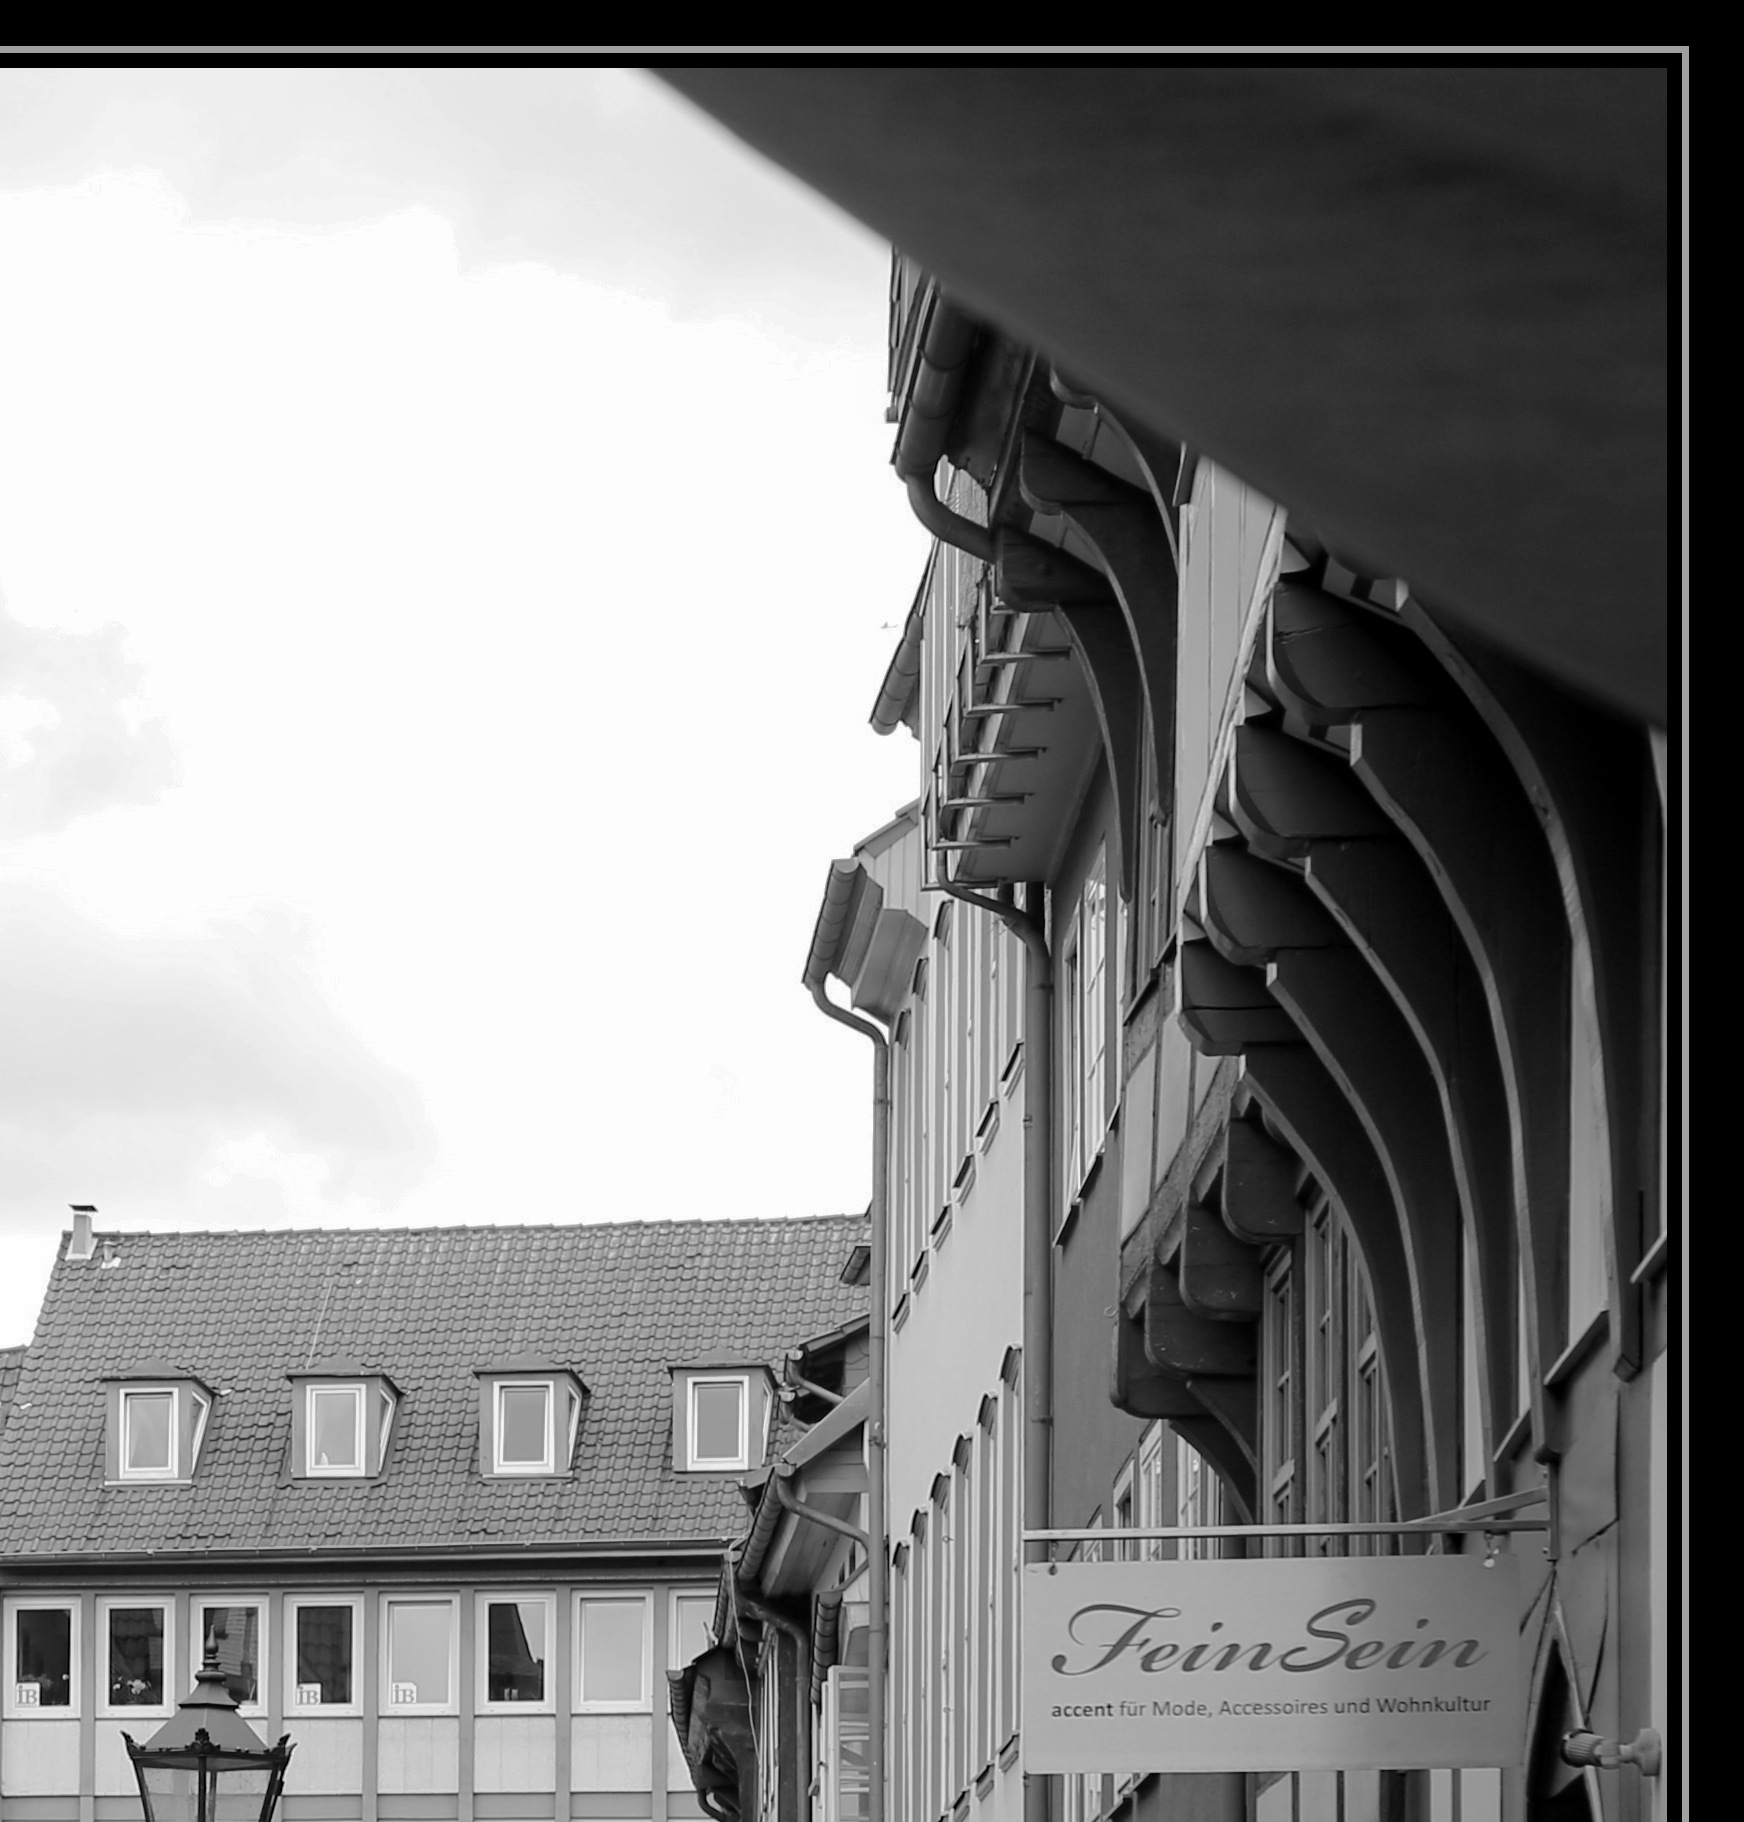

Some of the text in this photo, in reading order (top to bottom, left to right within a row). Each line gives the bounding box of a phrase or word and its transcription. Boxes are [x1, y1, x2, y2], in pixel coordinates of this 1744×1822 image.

[1051, 1597, 1489, 1676] FeinSein
[1050, 1696, 1492, 1719] accent für Mode, Accessoires und Wohnkultur
